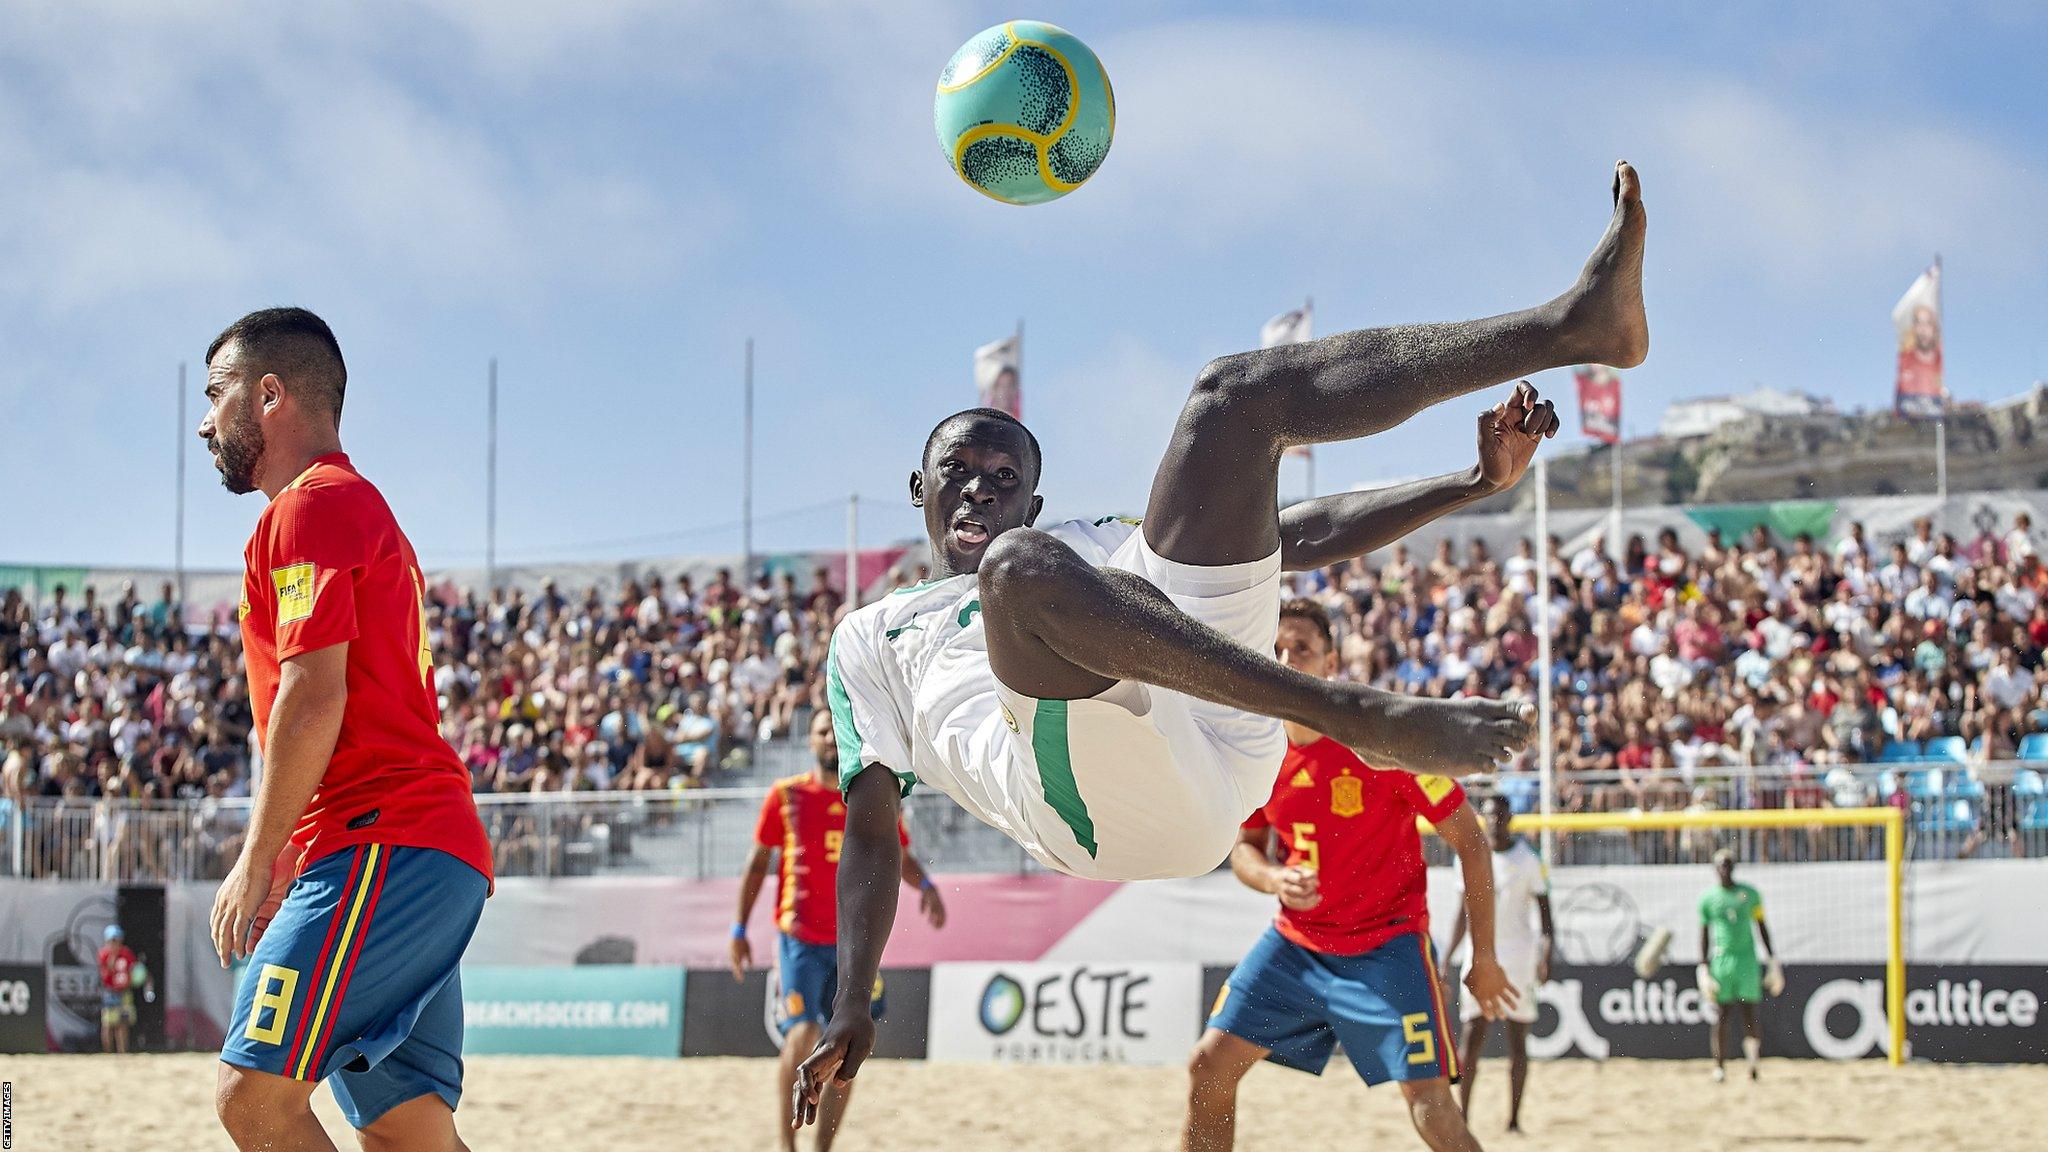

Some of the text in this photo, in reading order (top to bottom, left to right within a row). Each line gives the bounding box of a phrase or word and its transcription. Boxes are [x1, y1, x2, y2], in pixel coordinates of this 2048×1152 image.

[280, 585, 296, 597] FIFA
[824, 830, 843, 862] 9
[1293, 822, 1319, 870] 5
[244, 963, 299, 1046] 8
[980, 967, 1150, 1039] OESTE
[1906, 979, 2039, 1026] altice
[994, 1045, 1127, 1062] PORTUGAL
[1402, 1012, 1435, 1064] 5
